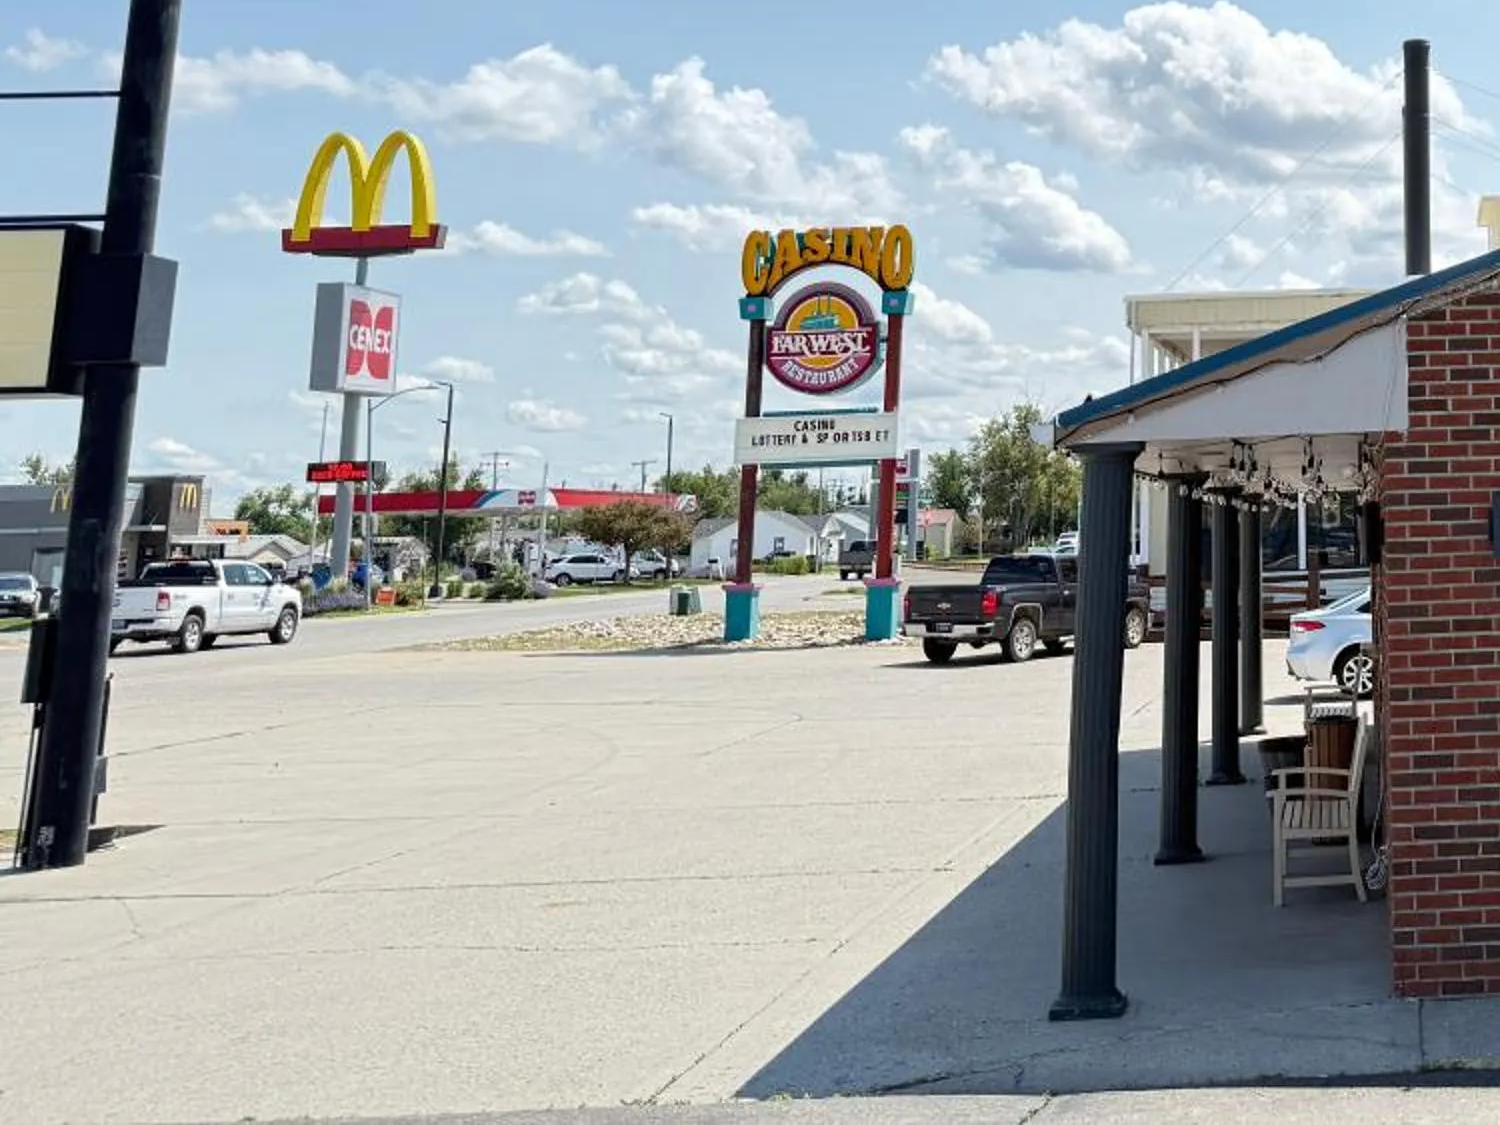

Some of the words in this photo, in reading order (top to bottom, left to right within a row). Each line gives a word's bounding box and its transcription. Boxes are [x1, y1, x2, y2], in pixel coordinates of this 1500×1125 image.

[741, 225, 913, 296] CASINO
[349, 323, 392, 355] CENEX
[781, 358, 860, 386] RESTAURANT
[793, 419, 836, 432] CASINO
[751, 433, 797, 447] LOTTERY
